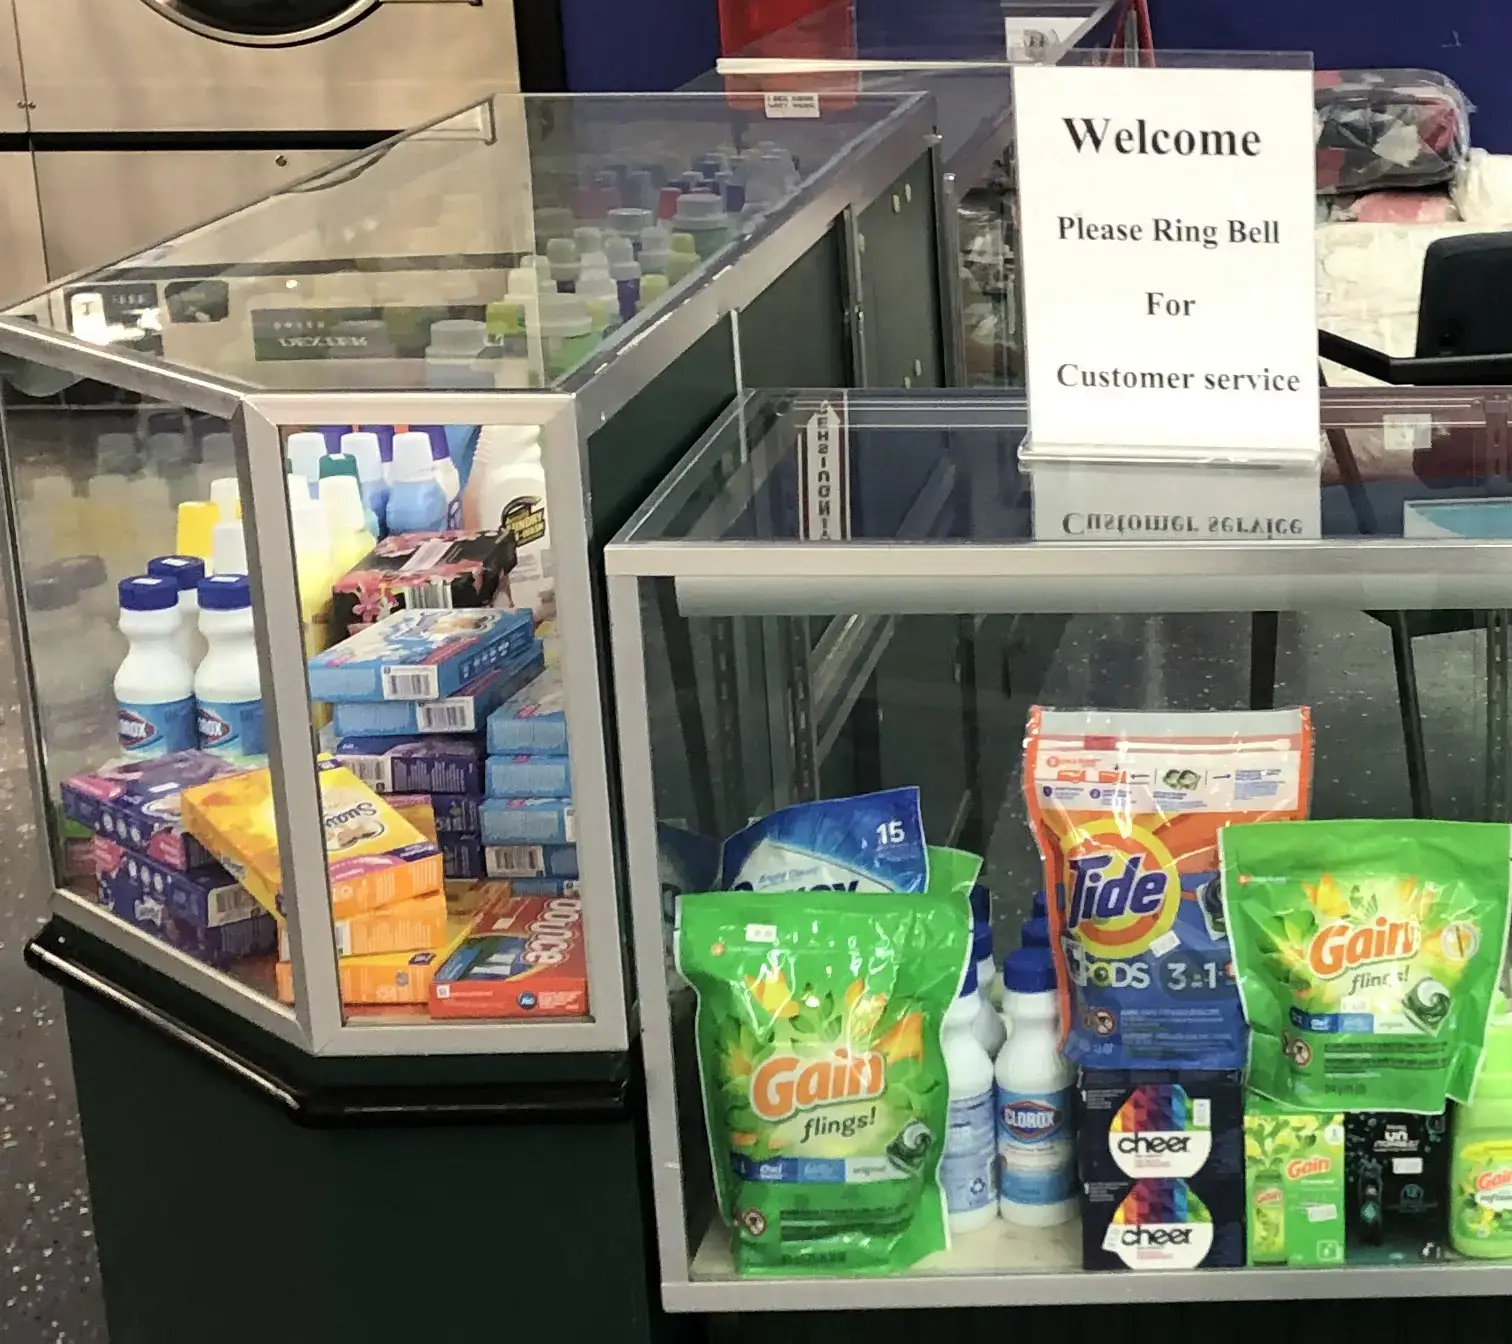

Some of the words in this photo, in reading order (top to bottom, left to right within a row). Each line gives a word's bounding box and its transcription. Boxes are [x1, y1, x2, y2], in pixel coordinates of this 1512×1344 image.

[1062, 117, 1262, 157] Welcome
[1057, 216, 1143, 242] Please
[1152, 218, 1218, 248] Ring
[1227, 220, 1280, 244] Bell
[1145, 292, 1197, 317] For
[1057, 363, 1196, 390] Customer
[1204, 368, 1301, 392] service
[876, 820, 906, 845] 15
[1068, 854, 1169, 929] Tide
[1308, 916, 1418, 976] Gain
[1348, 965, 1410, 996] flins!
[751, 1047, 885, 1119] Gain
[800, 1106, 877, 1144] flings!
[1004, 1108, 1055, 1129] CLOROX
[1117, 1132, 1192, 1154] cheer
[1286, 1155, 1331, 1181] Gain
[1120, 1223, 1193, 1246] cheer
